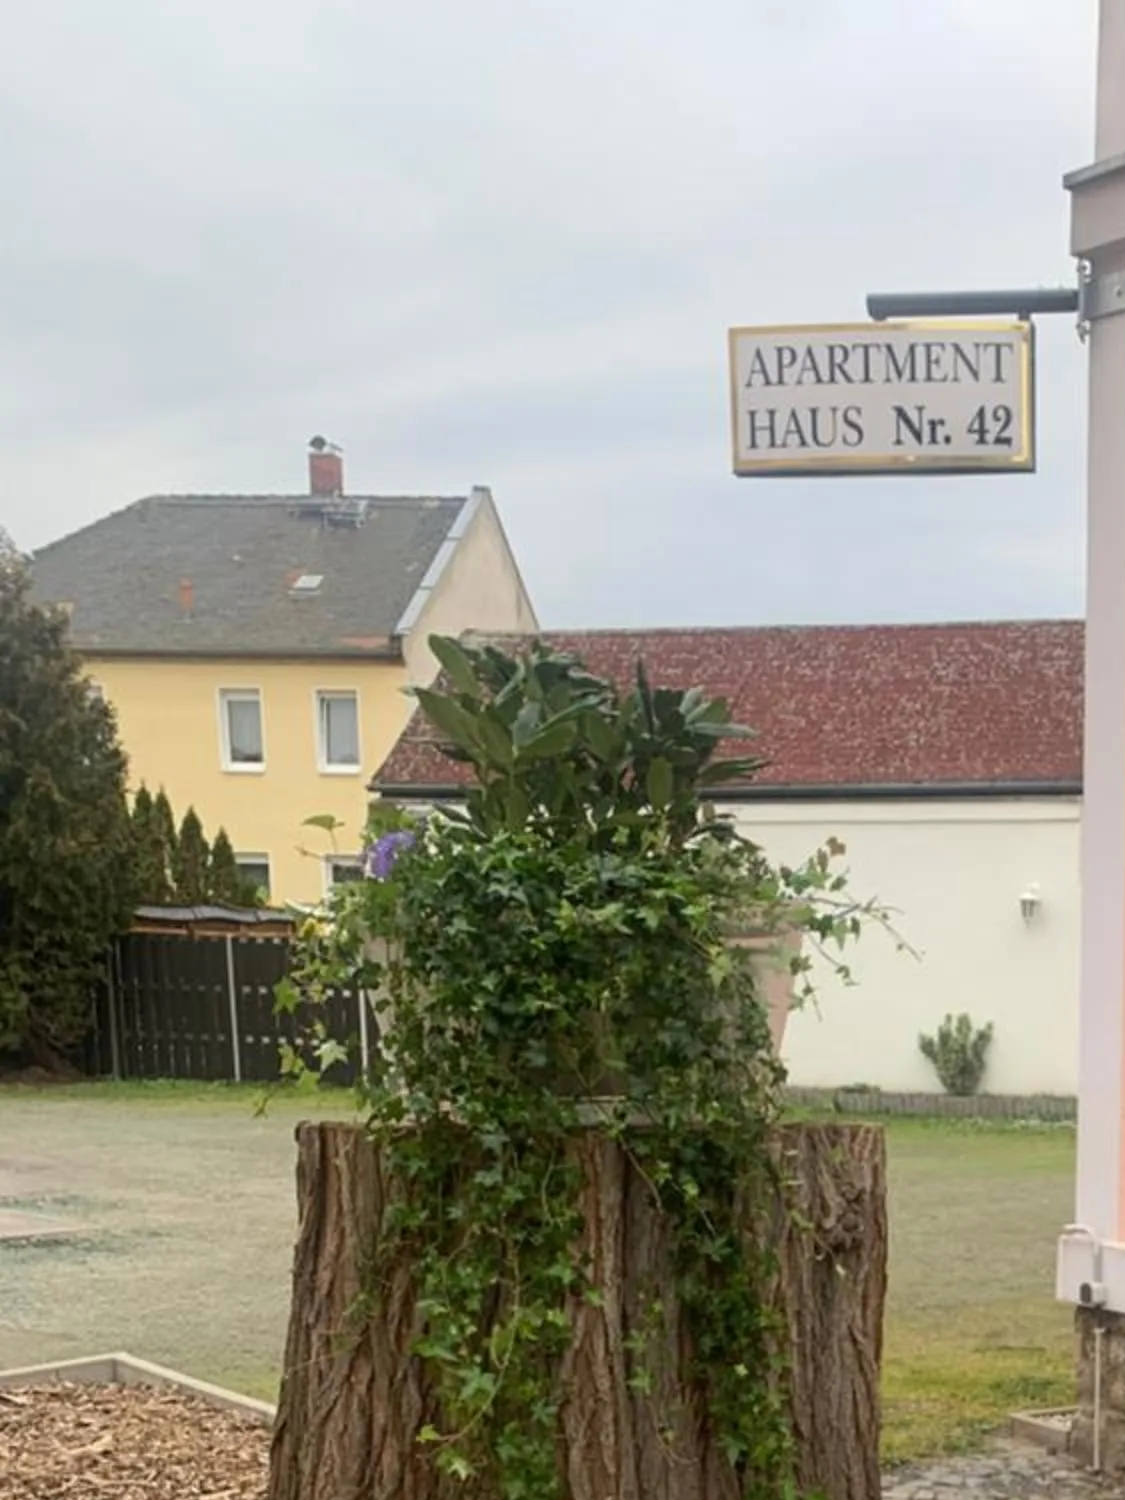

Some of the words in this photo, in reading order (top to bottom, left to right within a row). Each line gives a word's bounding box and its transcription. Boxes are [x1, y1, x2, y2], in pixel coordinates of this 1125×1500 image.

[745, 342, 1014, 388] APARTMENT
[746, 405, 864, 450] HAUS
[891, 405, 952, 446] Nr.
[967, 404, 1013, 448] 42
